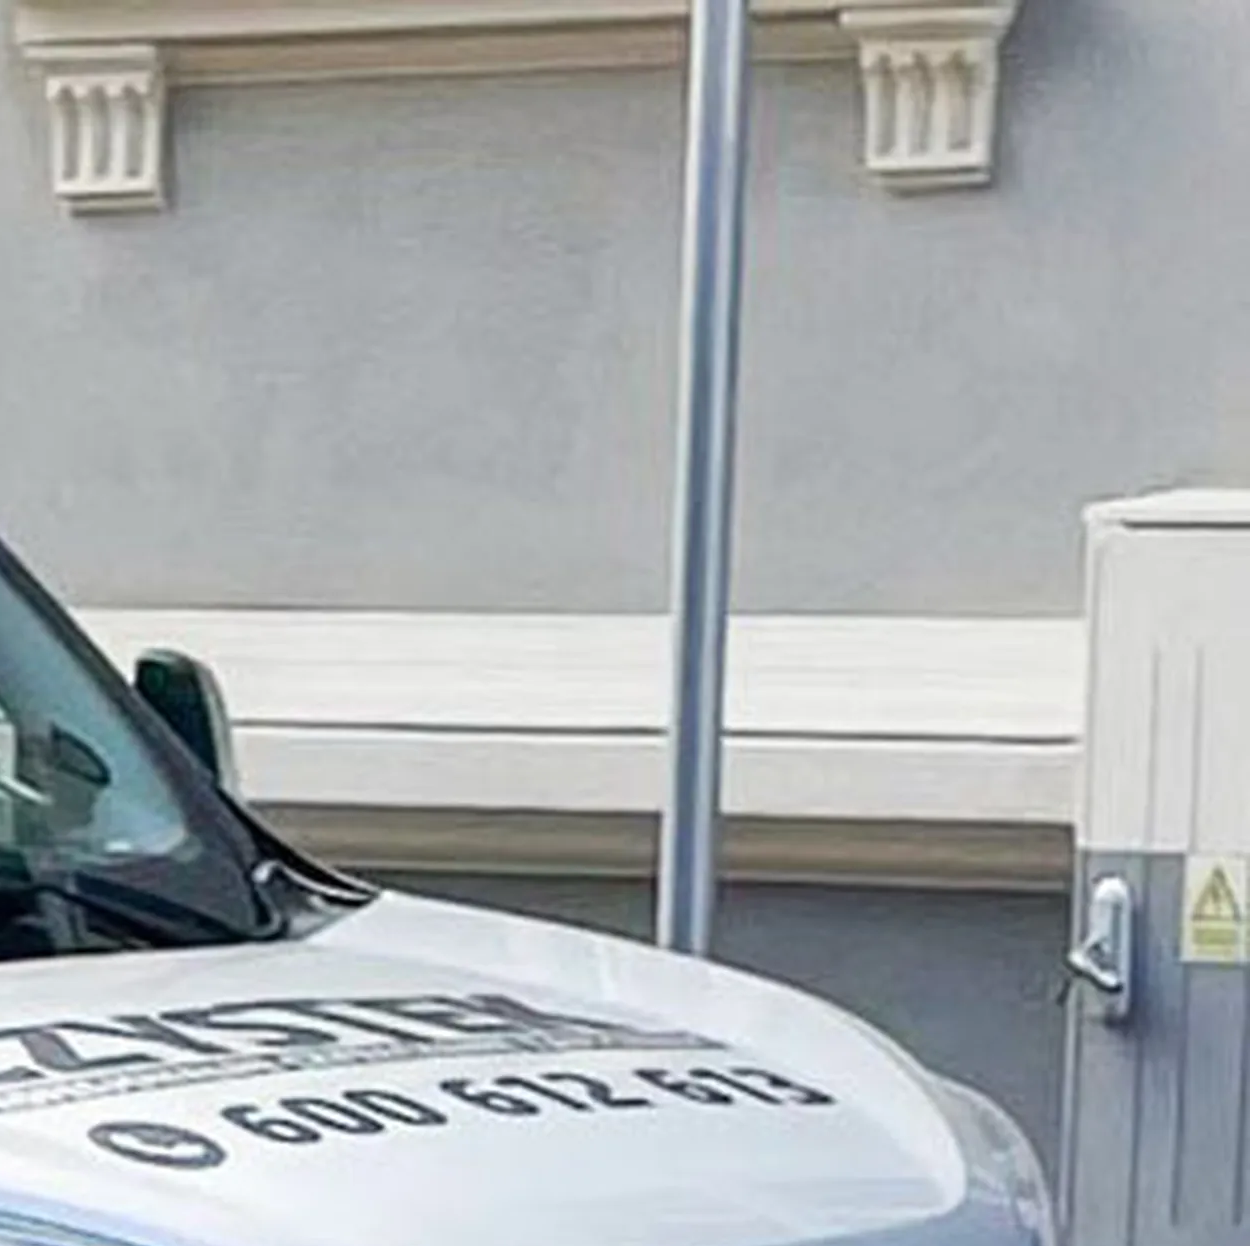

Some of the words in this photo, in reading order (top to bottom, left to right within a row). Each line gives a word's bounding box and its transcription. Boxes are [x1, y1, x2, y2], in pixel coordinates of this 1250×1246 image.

[221, 1089, 448, 1144] 600
[440, 1072, 656, 1115] 612
[632, 1066, 838, 1105] 613
